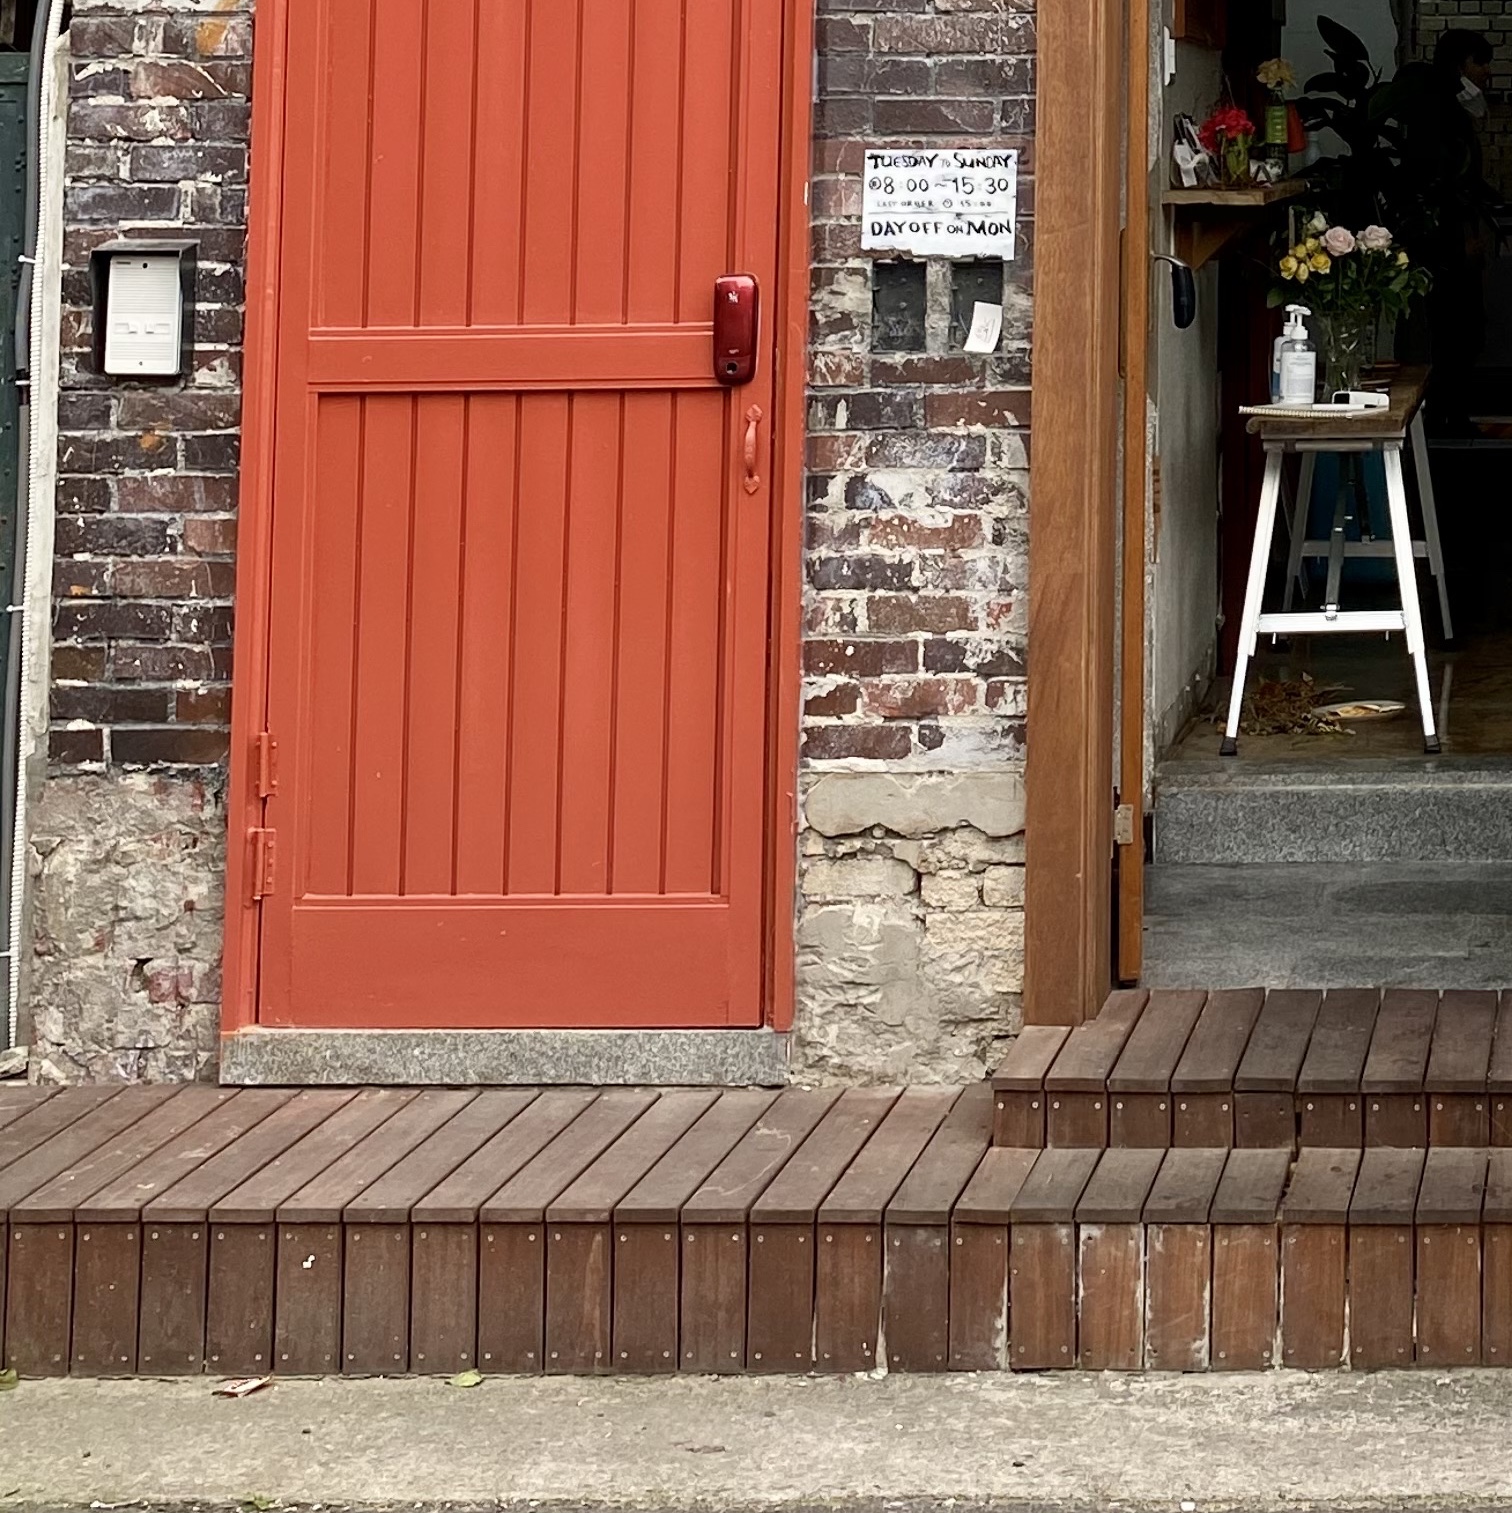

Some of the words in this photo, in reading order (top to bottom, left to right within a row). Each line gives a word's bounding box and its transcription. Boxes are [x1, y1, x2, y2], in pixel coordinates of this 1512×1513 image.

[867, 152, 939, 170] TUESDAY
[954, 151, 1012, 169] SUNDAY
[946, 224, 964, 235] ON
[966, 219, 1012, 236] MON
